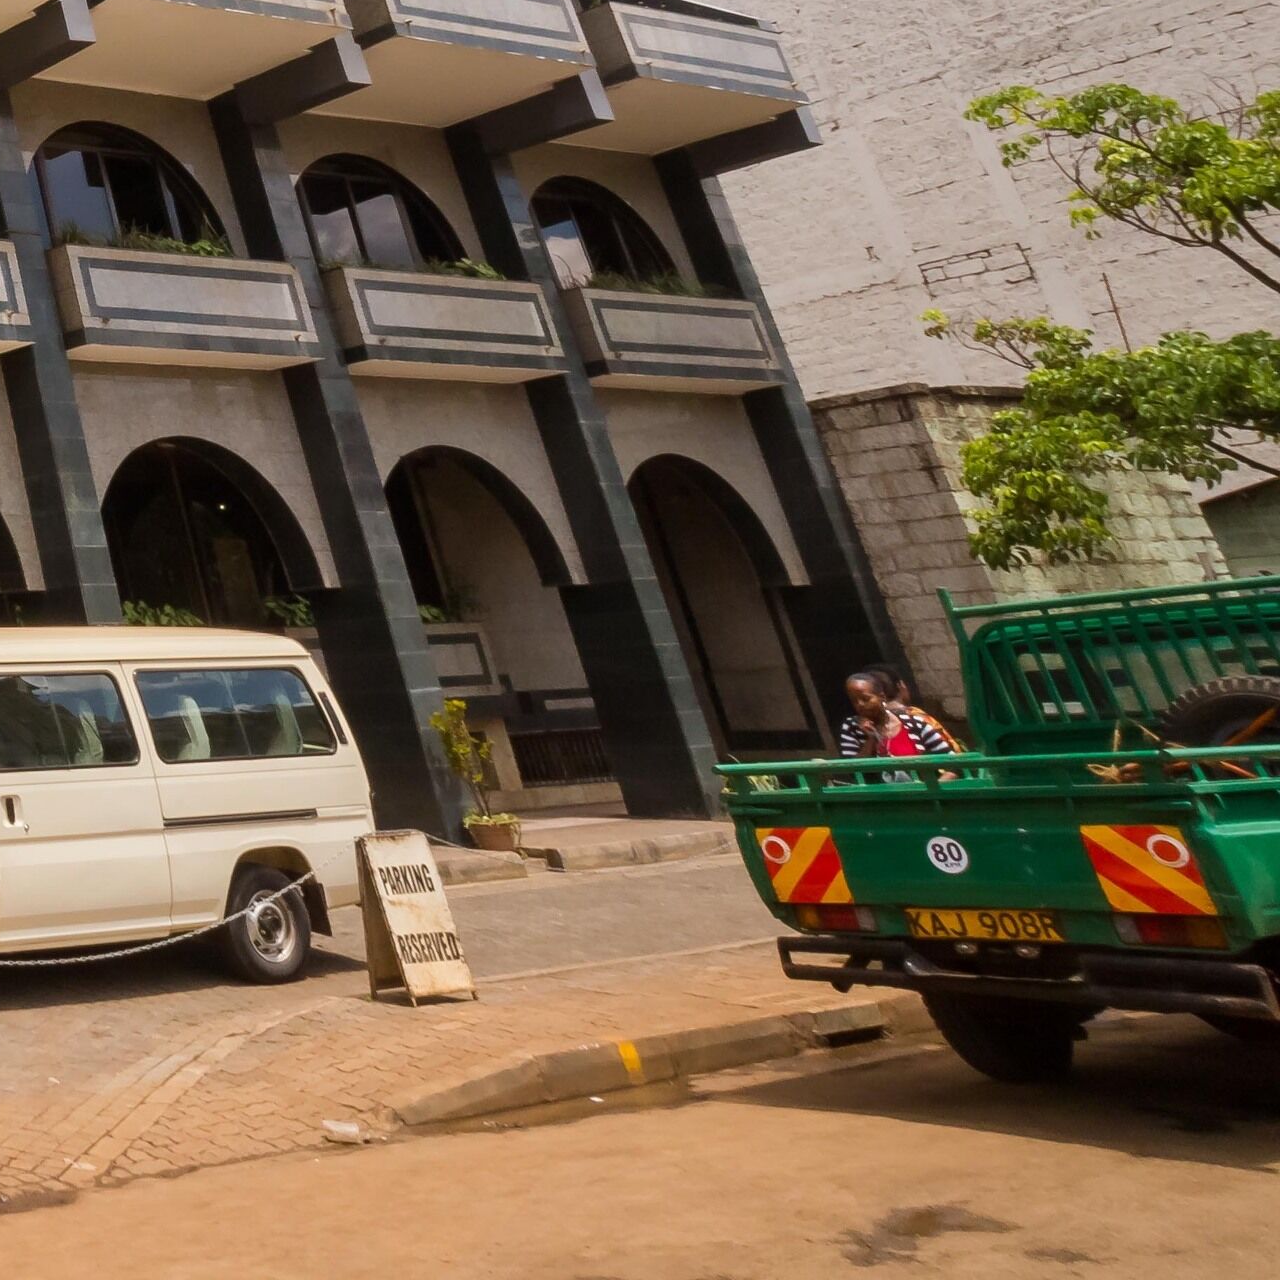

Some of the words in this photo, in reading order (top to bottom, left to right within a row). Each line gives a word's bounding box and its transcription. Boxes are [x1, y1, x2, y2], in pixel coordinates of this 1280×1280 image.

[931, 842, 963, 863] 80
[377, 863, 435, 896] PARKING
[907, 911, 968, 937] KAJ
[977, 911, 1054, 939] 908R
[396, 931, 461, 965] RESERVED
